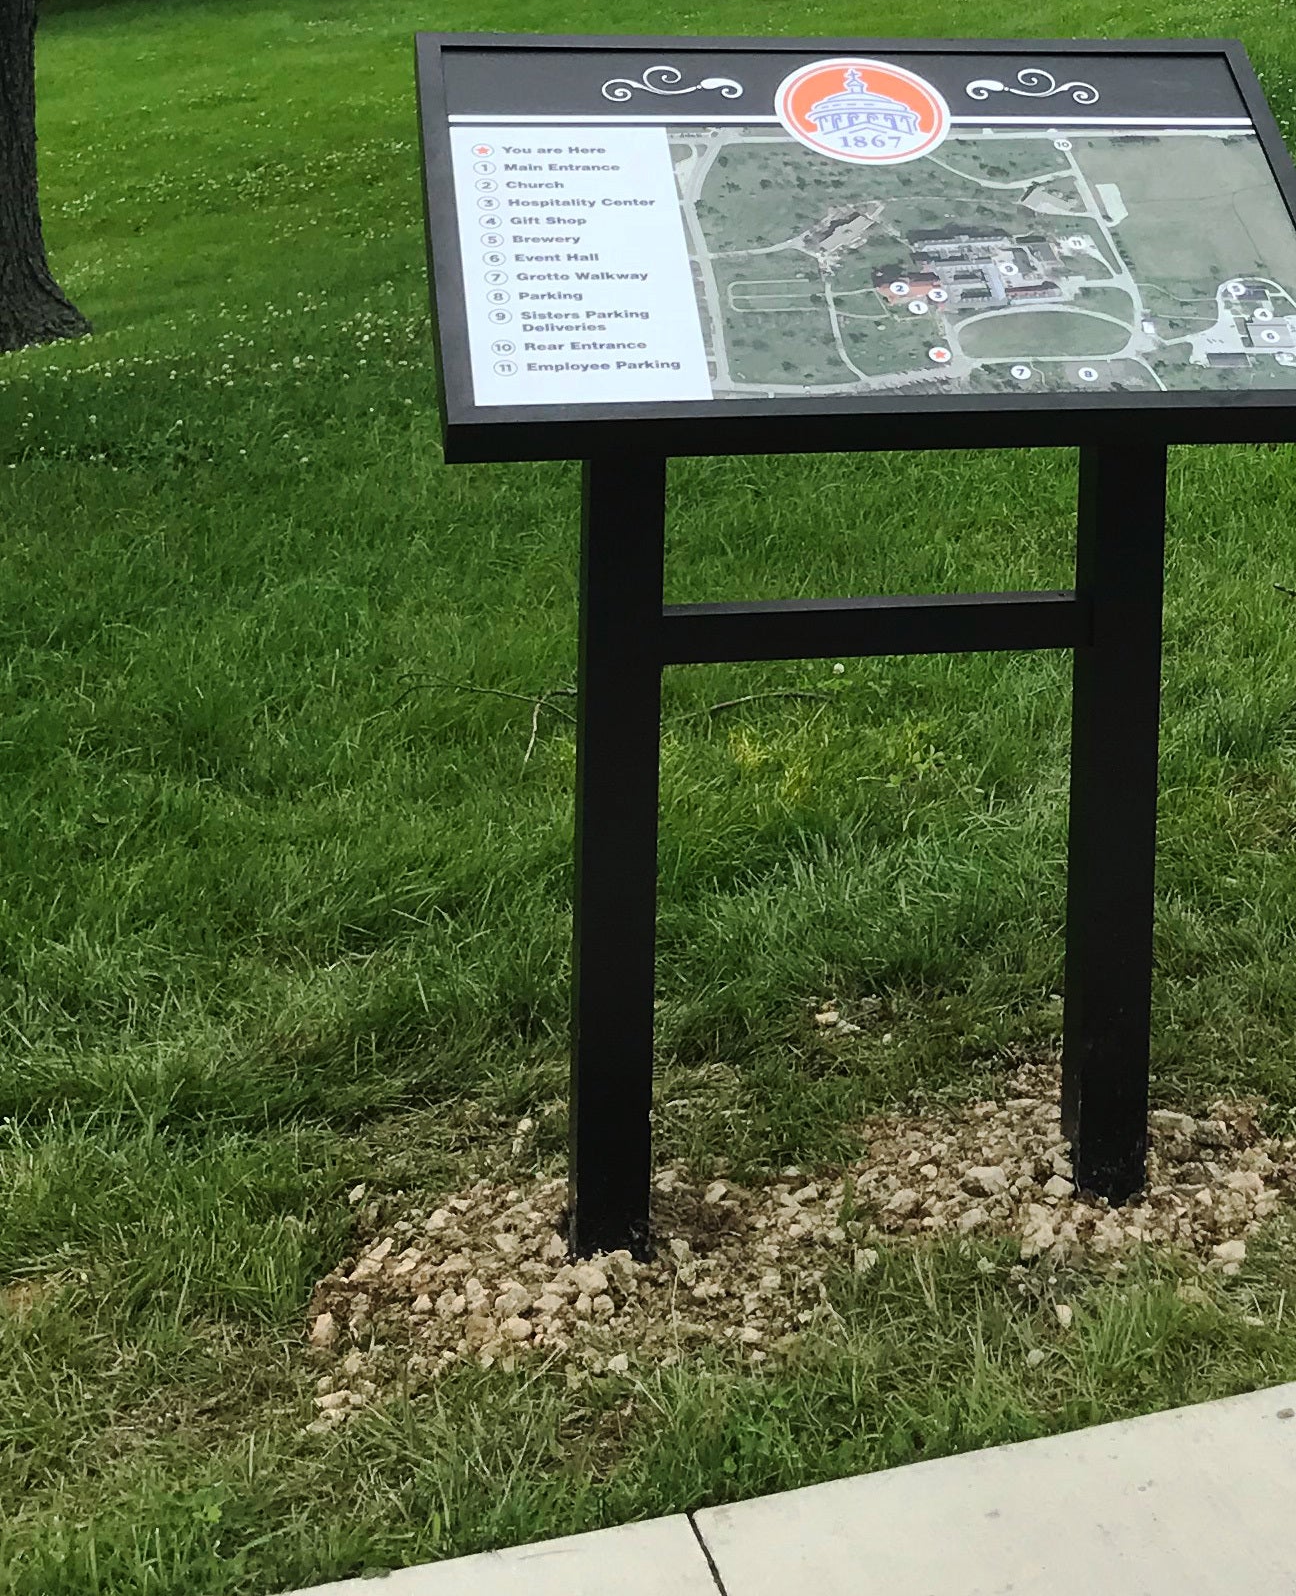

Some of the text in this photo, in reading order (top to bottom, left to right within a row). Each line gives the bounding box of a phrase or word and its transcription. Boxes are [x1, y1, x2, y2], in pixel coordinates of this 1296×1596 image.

[841, 136, 902, 148] 1867
[501, 146, 532, 154] You
[568, 146, 606, 154] Here
[480, 163, 620, 172] 1 Main Entrance
[481, 180, 565, 190] 2 Church
[484, 198, 656, 208] 3 Hospitality Center
[485, 216, 587, 226] 4 Gift Shop
[487, 235, 581, 245] 5 Brewery
[489, 253, 600, 263] 6 Event Hall
[491, 271, 648, 282] 7 Grotto Walkway
[493, 291, 583, 301] 8 Parking
[495, 309, 650, 321] 9 Sisters Parking
[522, 322, 607, 332] Deliveries
[494, 341, 647, 352] 10 Rear Entrance
[499, 360, 681, 373] 11 Employee Parking
[1017, 369, 1025, 377] 7
